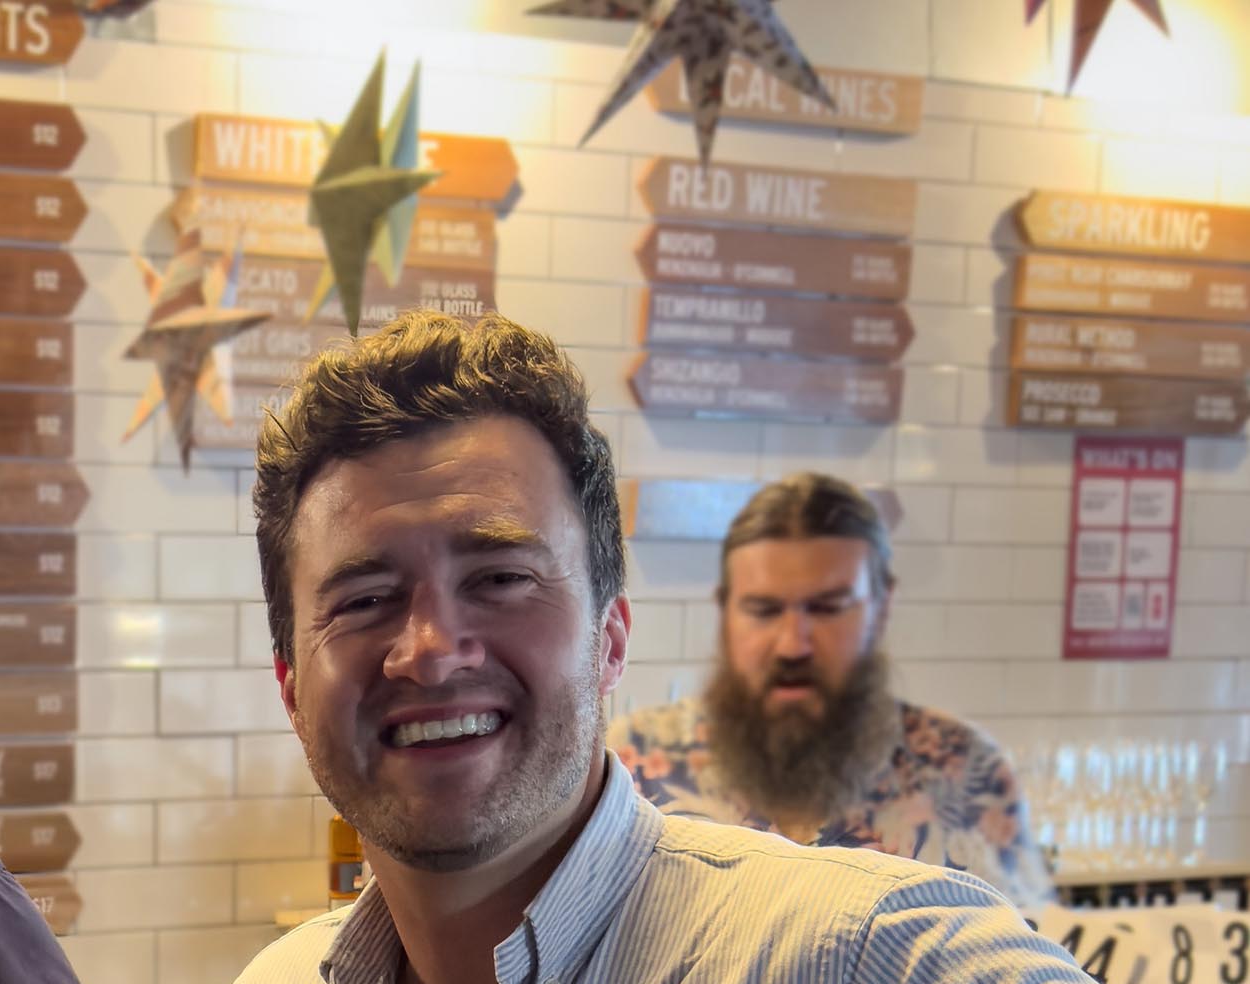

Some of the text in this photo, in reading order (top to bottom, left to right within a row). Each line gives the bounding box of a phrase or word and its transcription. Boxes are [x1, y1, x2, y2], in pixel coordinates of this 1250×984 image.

[667, 163, 828, 221] RED WINE
[1049, 199, 1211, 251] SPARKLING
[362, 304, 397, 322] LAINS
[443, 299, 484, 317] BOTTLE
